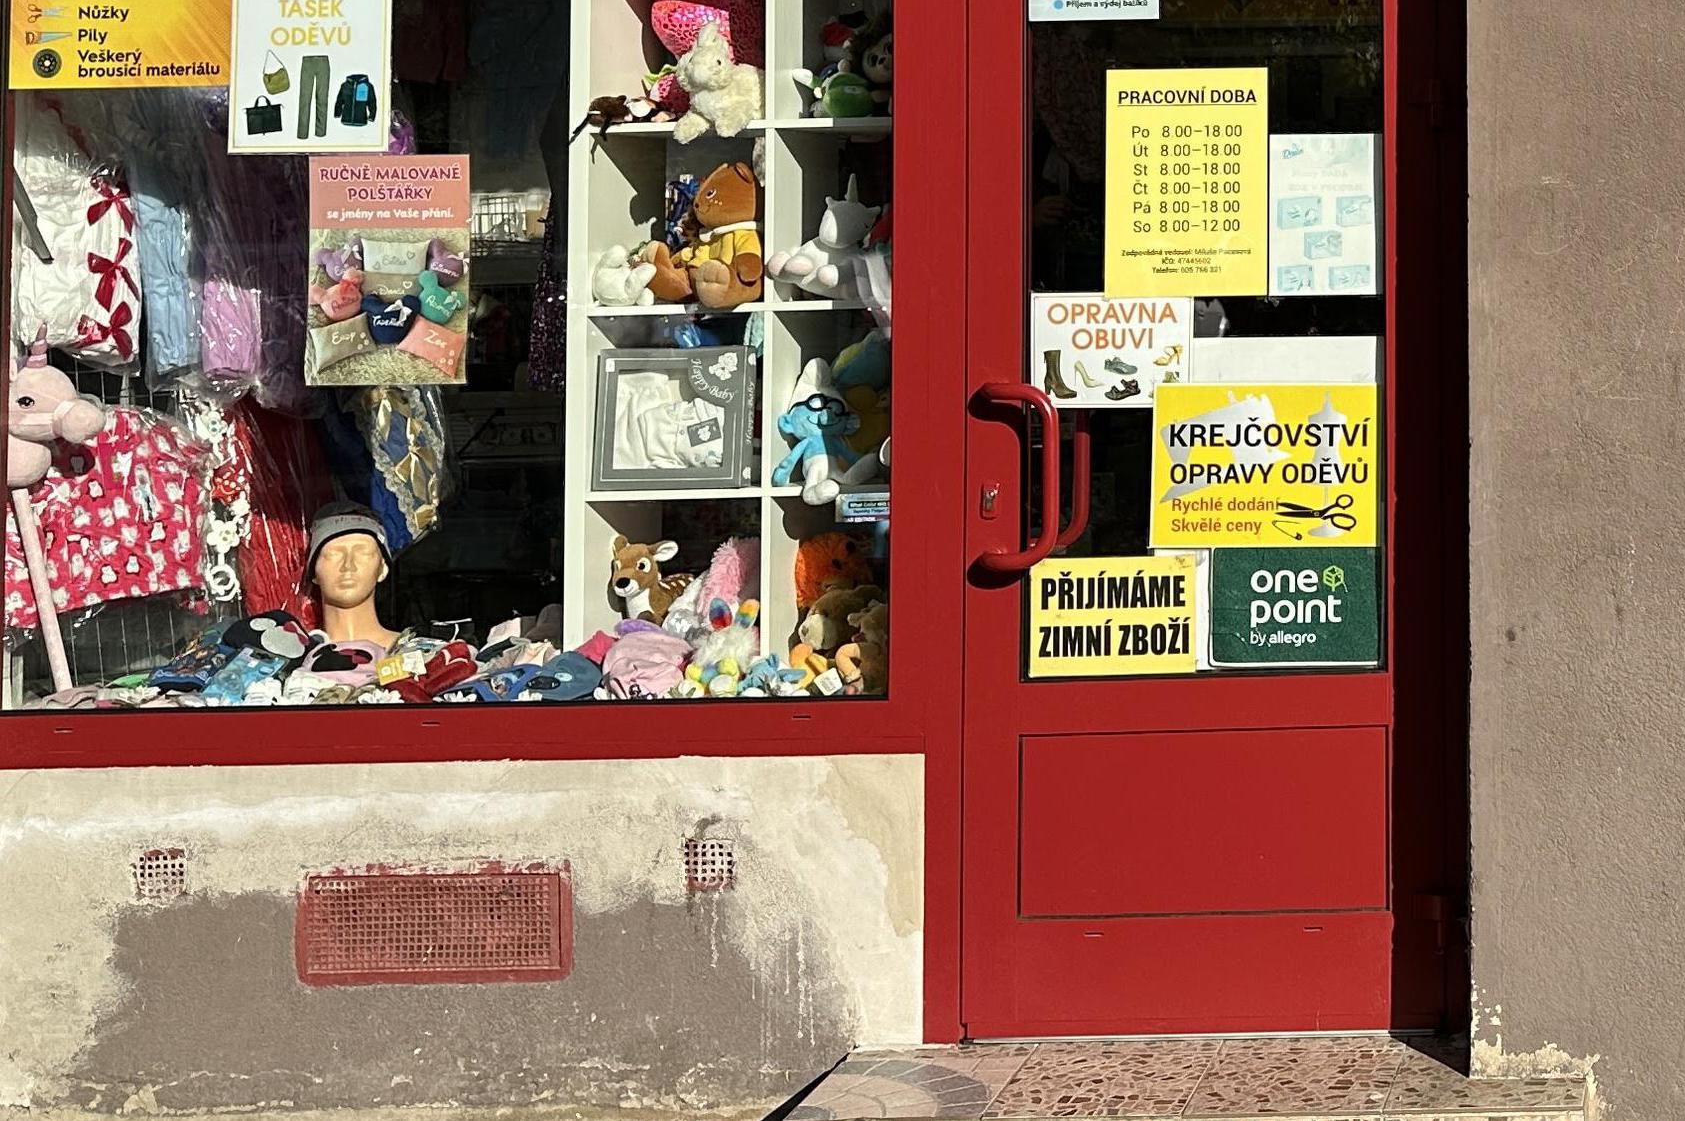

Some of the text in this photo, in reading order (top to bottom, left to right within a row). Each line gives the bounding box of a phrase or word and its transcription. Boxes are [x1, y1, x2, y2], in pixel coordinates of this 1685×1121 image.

[78, 6, 129, 22] Nůžky
[78, 29, 108, 44] Pily
[270, 22, 352, 47] ODĚVŮ
[78, 49, 142, 64] Veškerý
[146, 62, 221, 76] materiálu
[1118, 86, 1257, 104] PRACOVNÍ DOBA
[1131, 125, 1150, 138] Po
[1133, 141, 1149, 157] Út
[319, 164, 461, 181] RUČNĚ MALOVANÉ
[1133, 163, 1148, 176] St
[347, 183, 433, 200] POLŠTÁŘKY
[1133, 179, 1148, 195] Čt
[327, 210, 338, 219] se
[340, 208, 374, 222] jmény
[377, 210, 390, 219] na
[422, 207, 454, 220] přání.
[1133, 200, 1151, 214] Pá
[1133, 220, 1151, 233] So
[1047, 302, 1178, 325] OPRAVNA
[1071, 328, 1154, 350] OBUVI
[1169, 417, 1371, 448] KREJČOVSTVÍ
[1169, 456, 1369, 485] OPRAVY ODĚVŮ
[1171, 495, 1280, 515] Rychlé dodání
[1171, 516, 1263, 537] Skvělé ceny
[1250, 568, 1318, 593] one
[1041, 569, 1186, 610] PŘIJÍMÁME
[1250, 595, 1343, 628] point
[1038, 617, 1192, 658] ZIMNÍ ZBOŽÍ
[1249, 629, 1317, 646] by allegro
